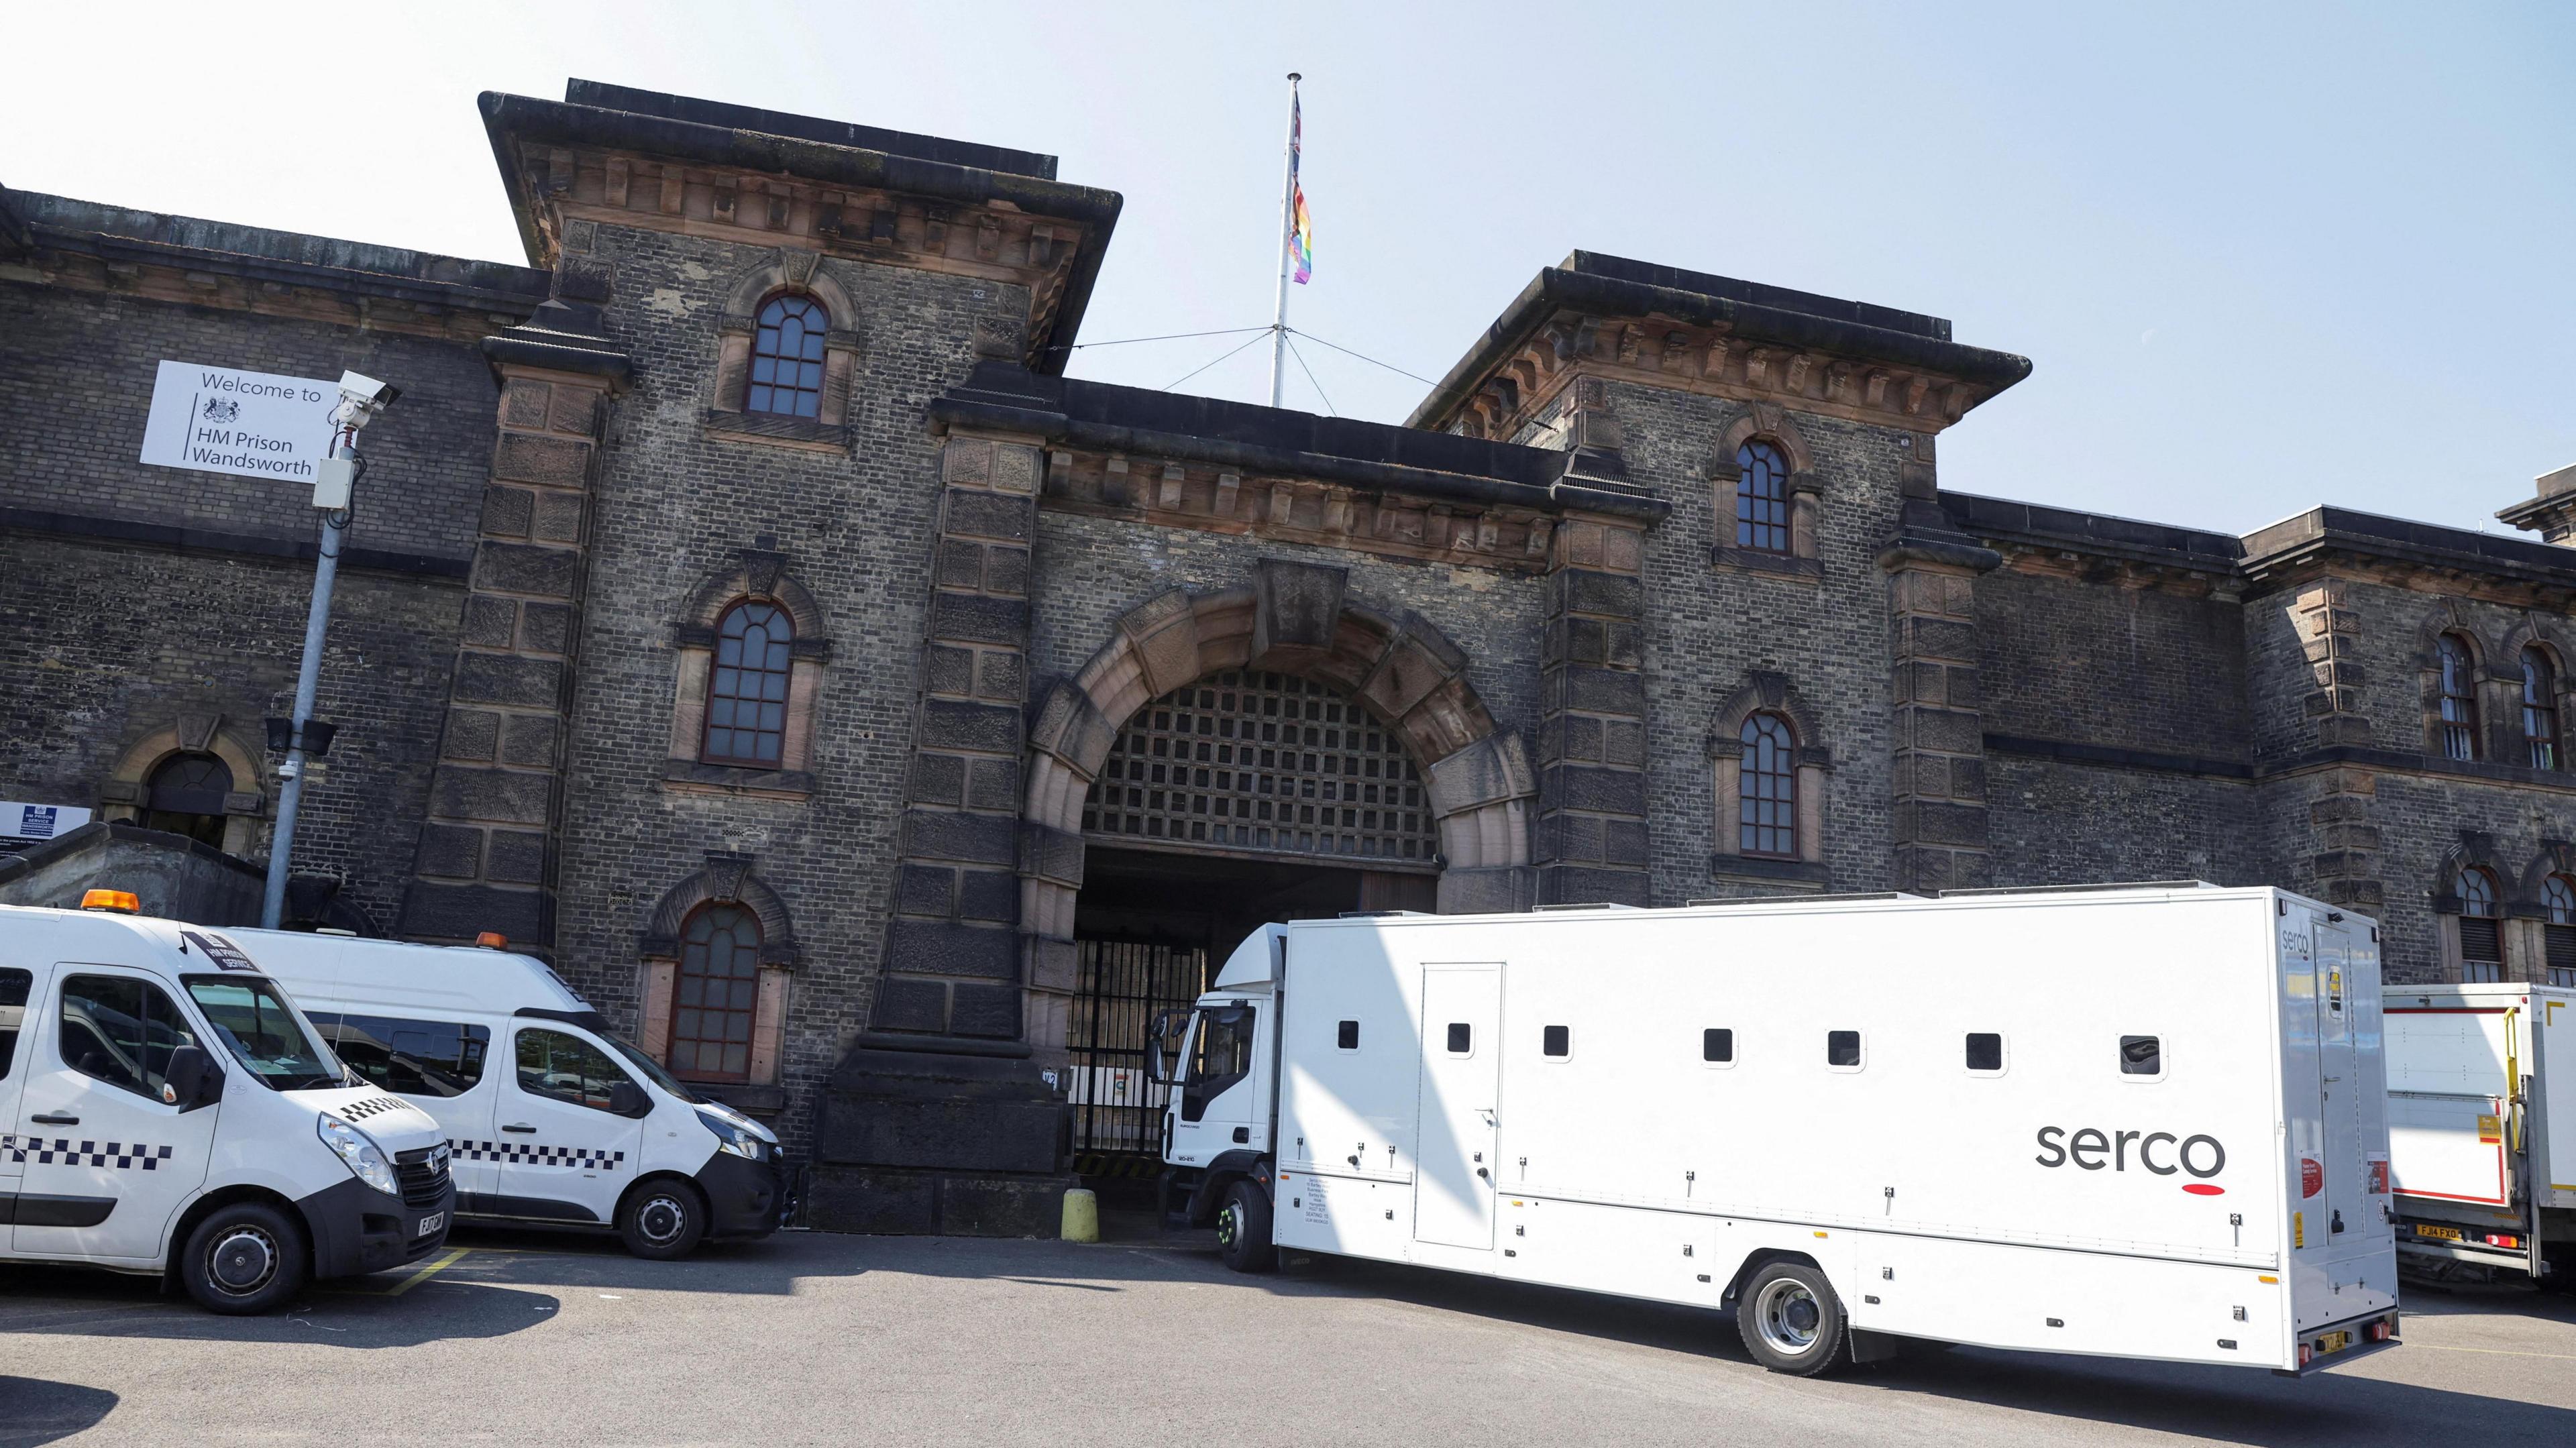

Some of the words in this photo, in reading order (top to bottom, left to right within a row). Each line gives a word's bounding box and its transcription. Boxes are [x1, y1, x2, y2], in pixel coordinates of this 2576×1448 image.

[203, 372, 294, 399] Welcome
[302, 388, 321, 402] to
[197, 427, 230, 445] HM
[235, 432, 292, 453] Prison
[193, 447, 311, 476] Wandsworth
[207, 948, 224, 957] HM
[219, 949, 248, 960] PRISON
[2282, 930, 2308, 954] serco
[223, 958, 254, 969] SERVICE
[2035, 1126, 2226, 1178] serco
[2422, 1226, 2438, 1236] FJ14
